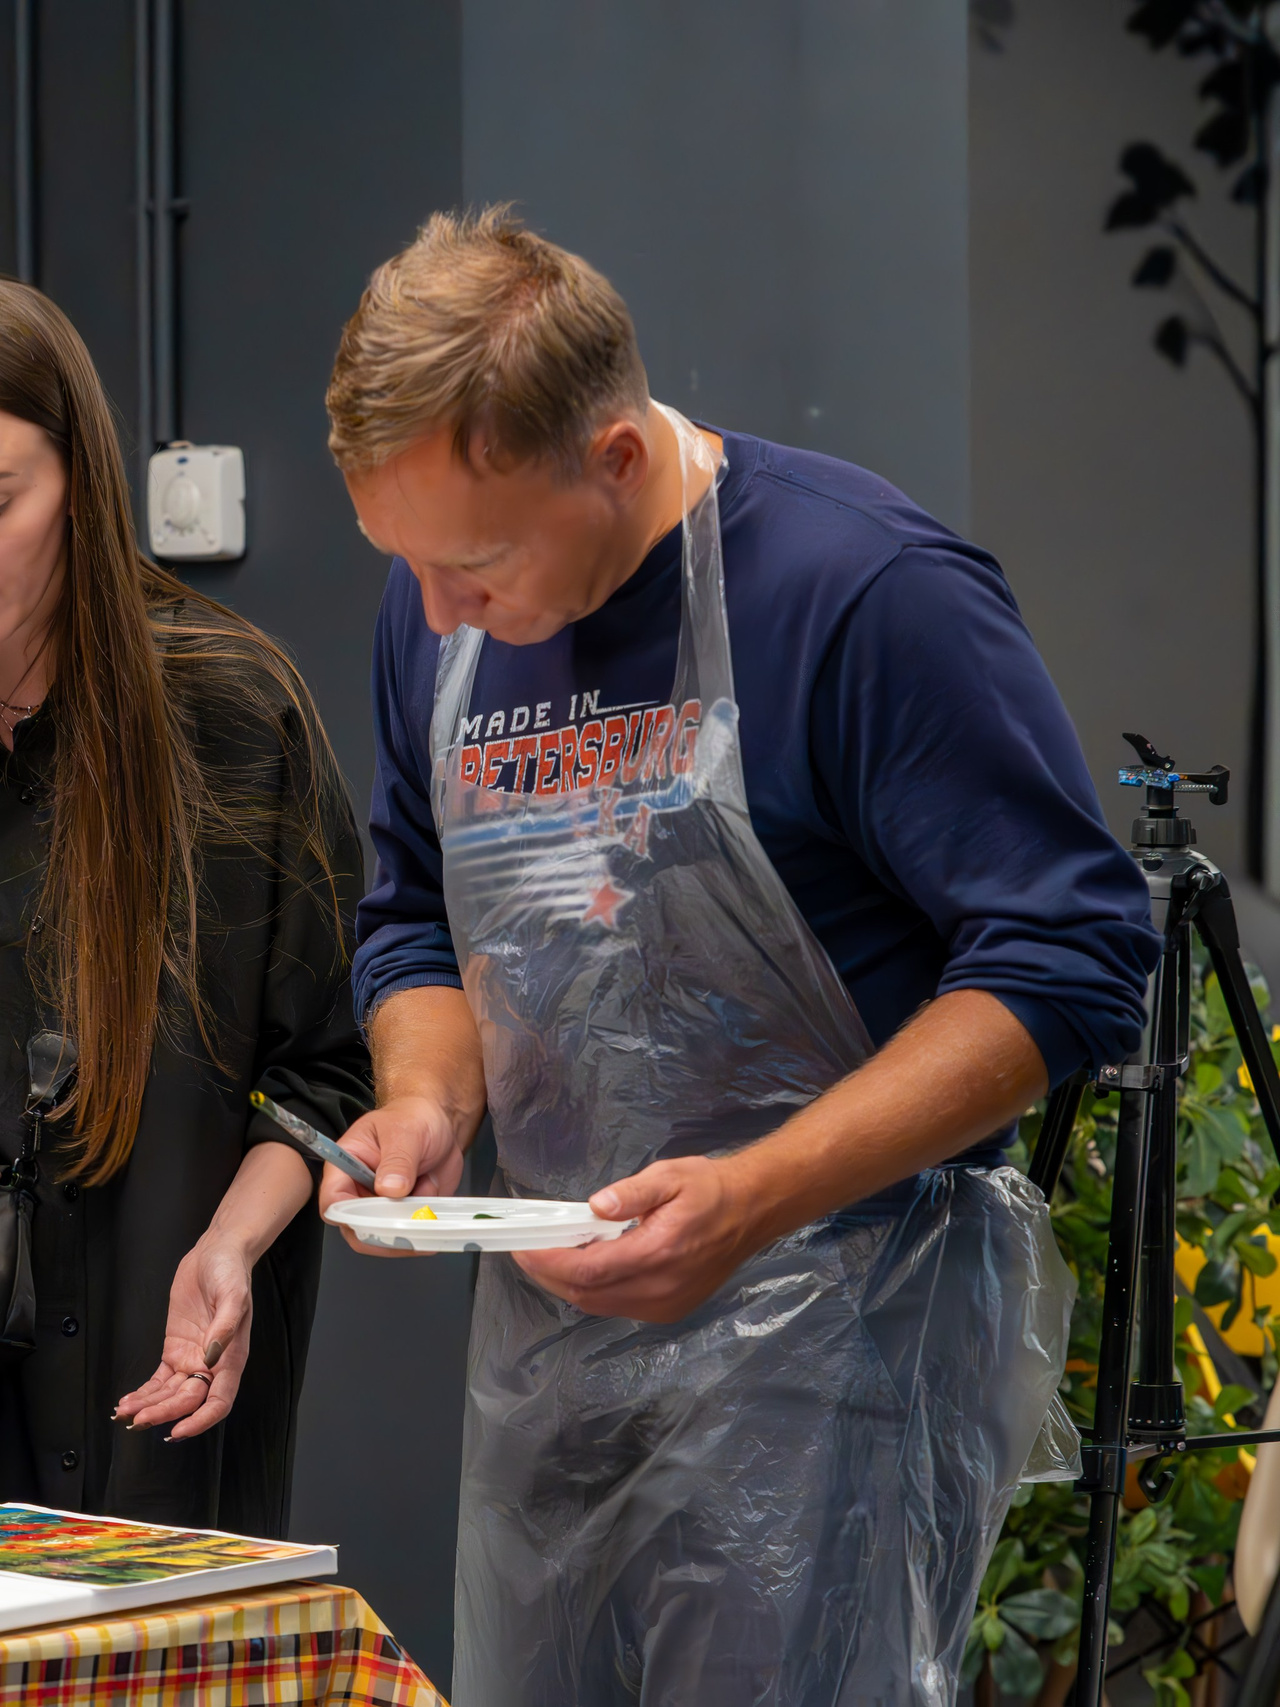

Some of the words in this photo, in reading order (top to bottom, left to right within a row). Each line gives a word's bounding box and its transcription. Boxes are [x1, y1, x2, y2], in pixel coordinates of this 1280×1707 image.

[460, 701, 552, 740] MADE
[569, 689, 601, 720] IN
[460, 698, 702, 800] PETERSBURG
